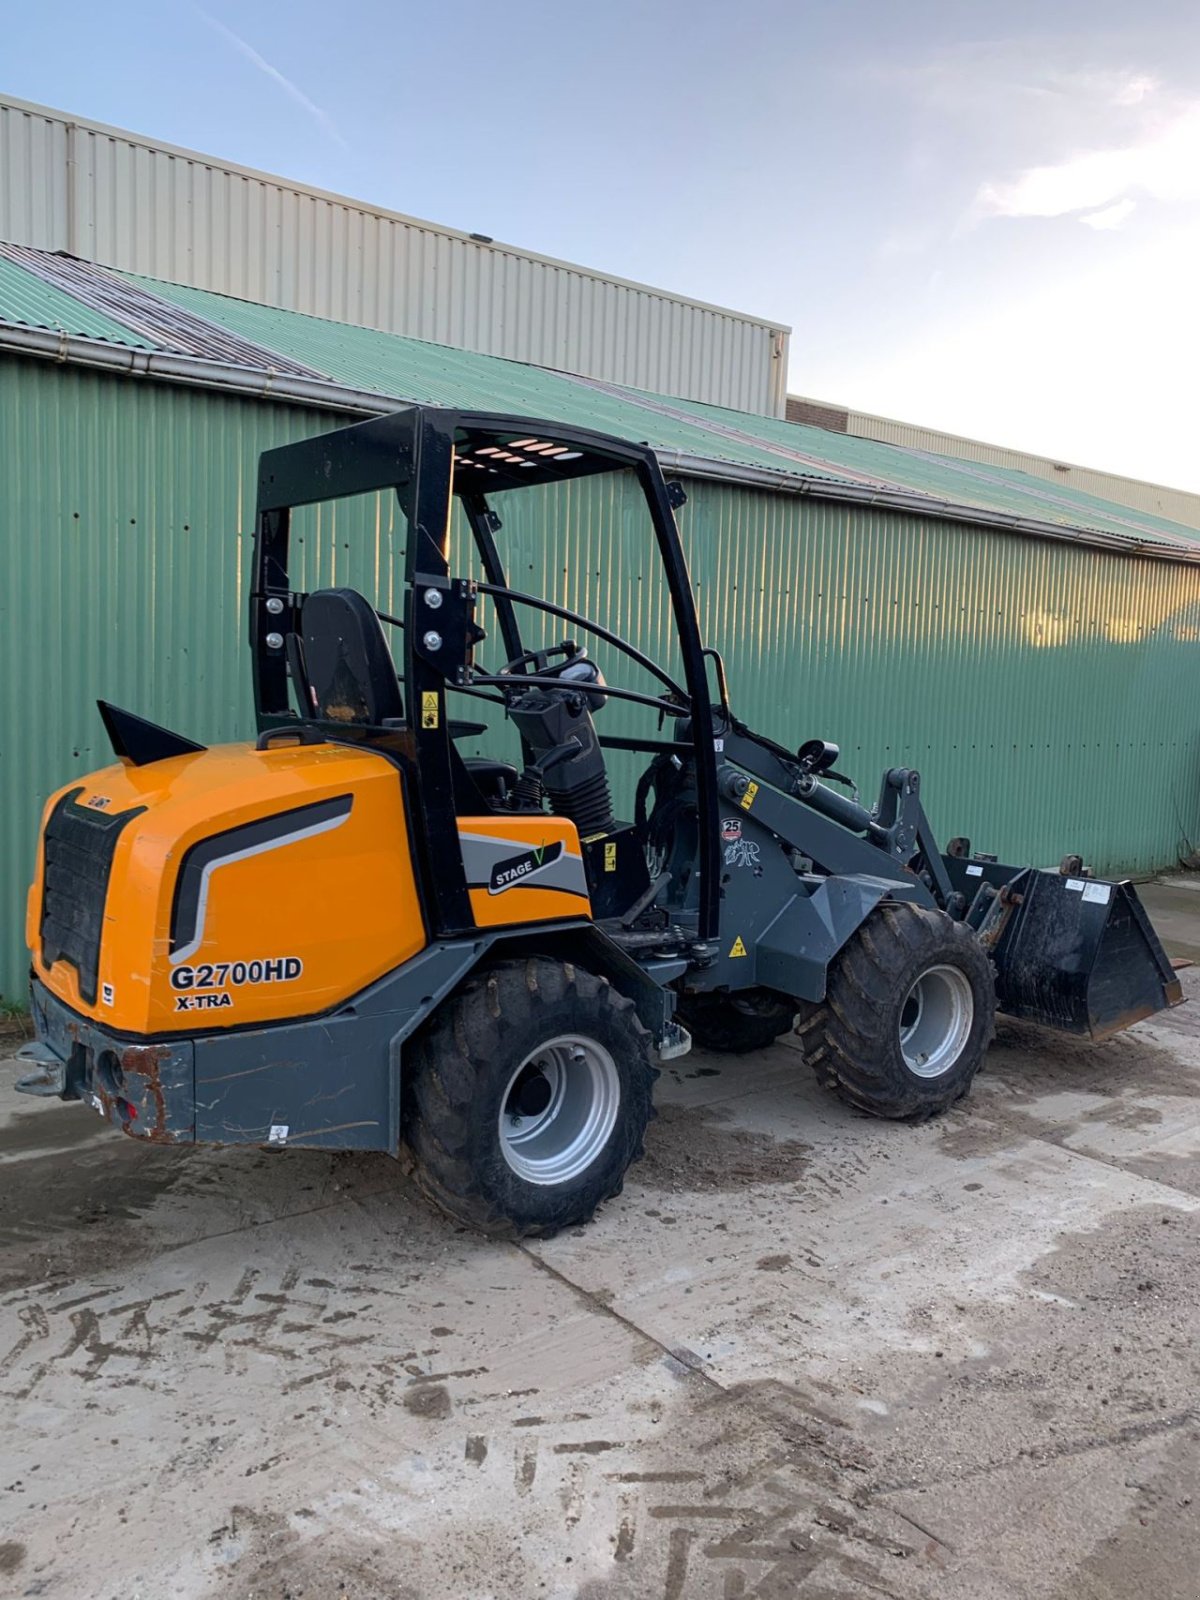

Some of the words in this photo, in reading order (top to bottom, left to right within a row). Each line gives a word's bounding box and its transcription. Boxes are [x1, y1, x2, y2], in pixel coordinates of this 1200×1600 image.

[725, 821, 739, 832] 25
[496, 861, 533, 885] STAGE
[533, 839, 546, 866] V
[171, 957, 302, 990] G2700HD
[176, 993, 232, 1011] X-TRA
